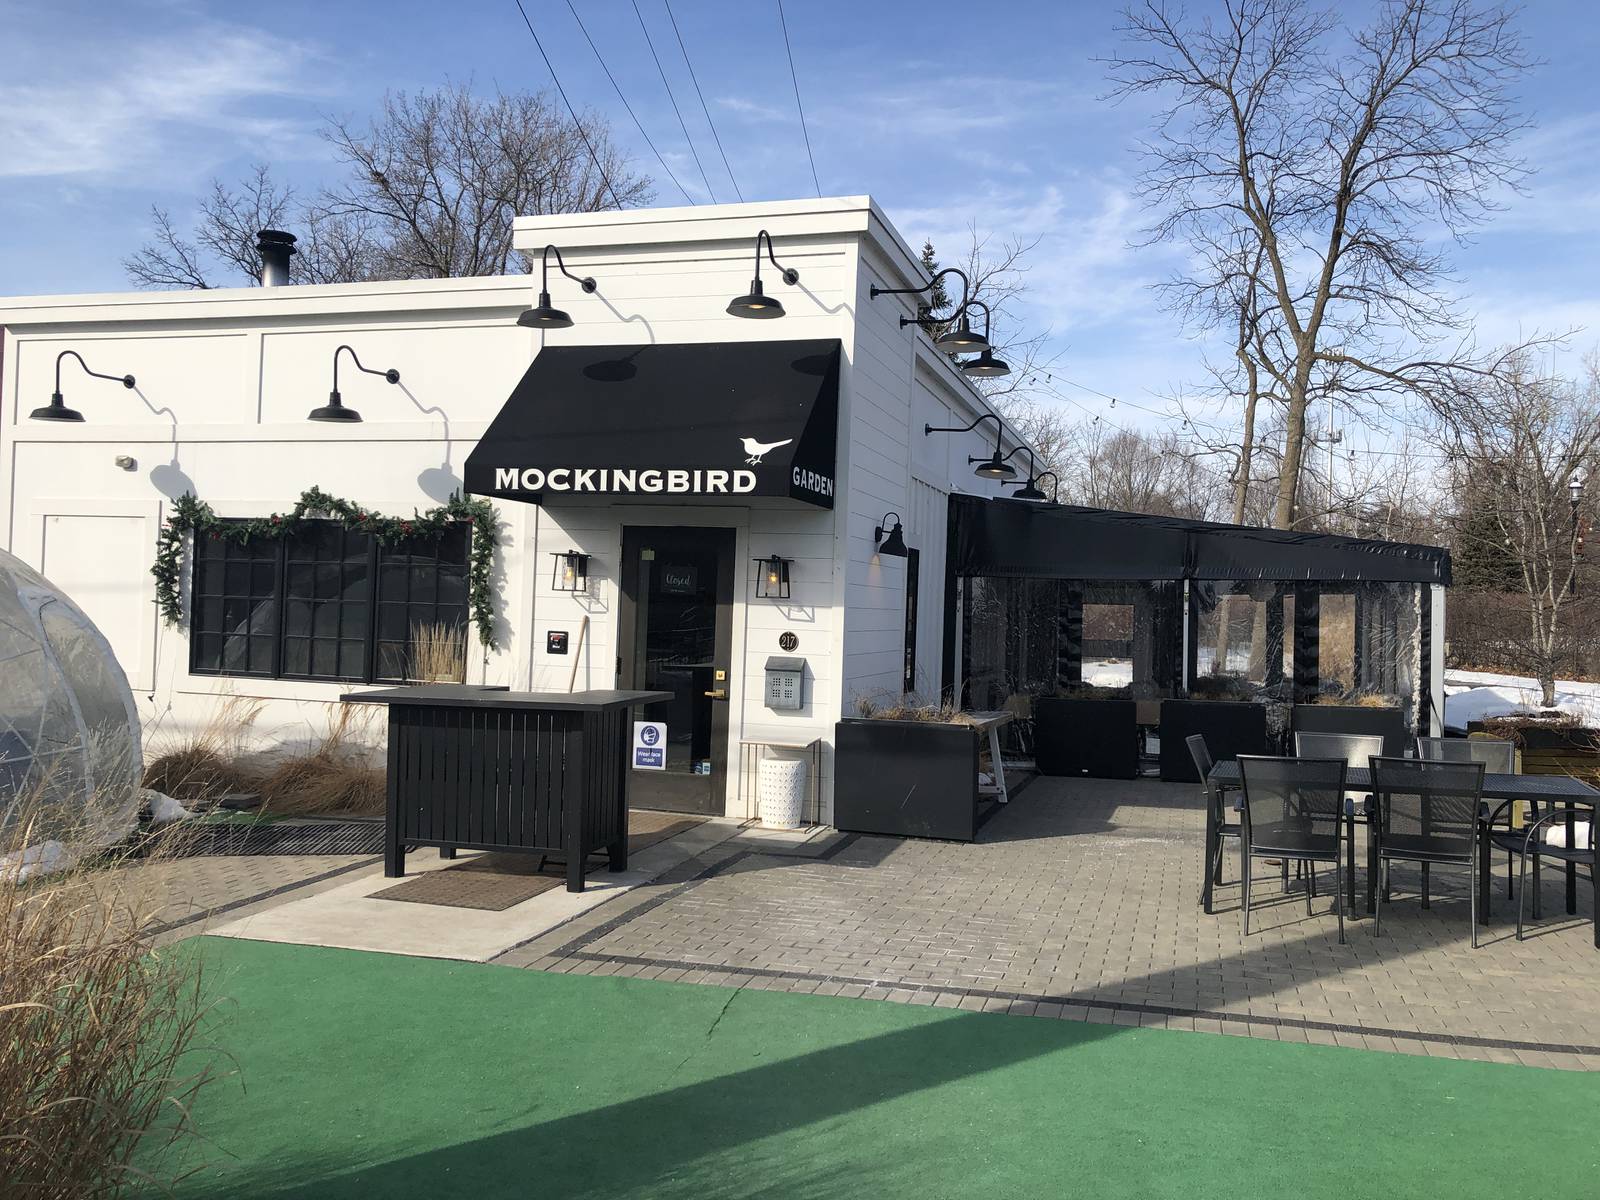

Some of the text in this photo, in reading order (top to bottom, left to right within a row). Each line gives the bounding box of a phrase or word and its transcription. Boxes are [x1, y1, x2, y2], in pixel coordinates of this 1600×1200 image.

[494, 468, 757, 493] MOCKINGBIRD
[793, 466, 833, 497] GARDEN
[781, 635, 796, 648] 217
